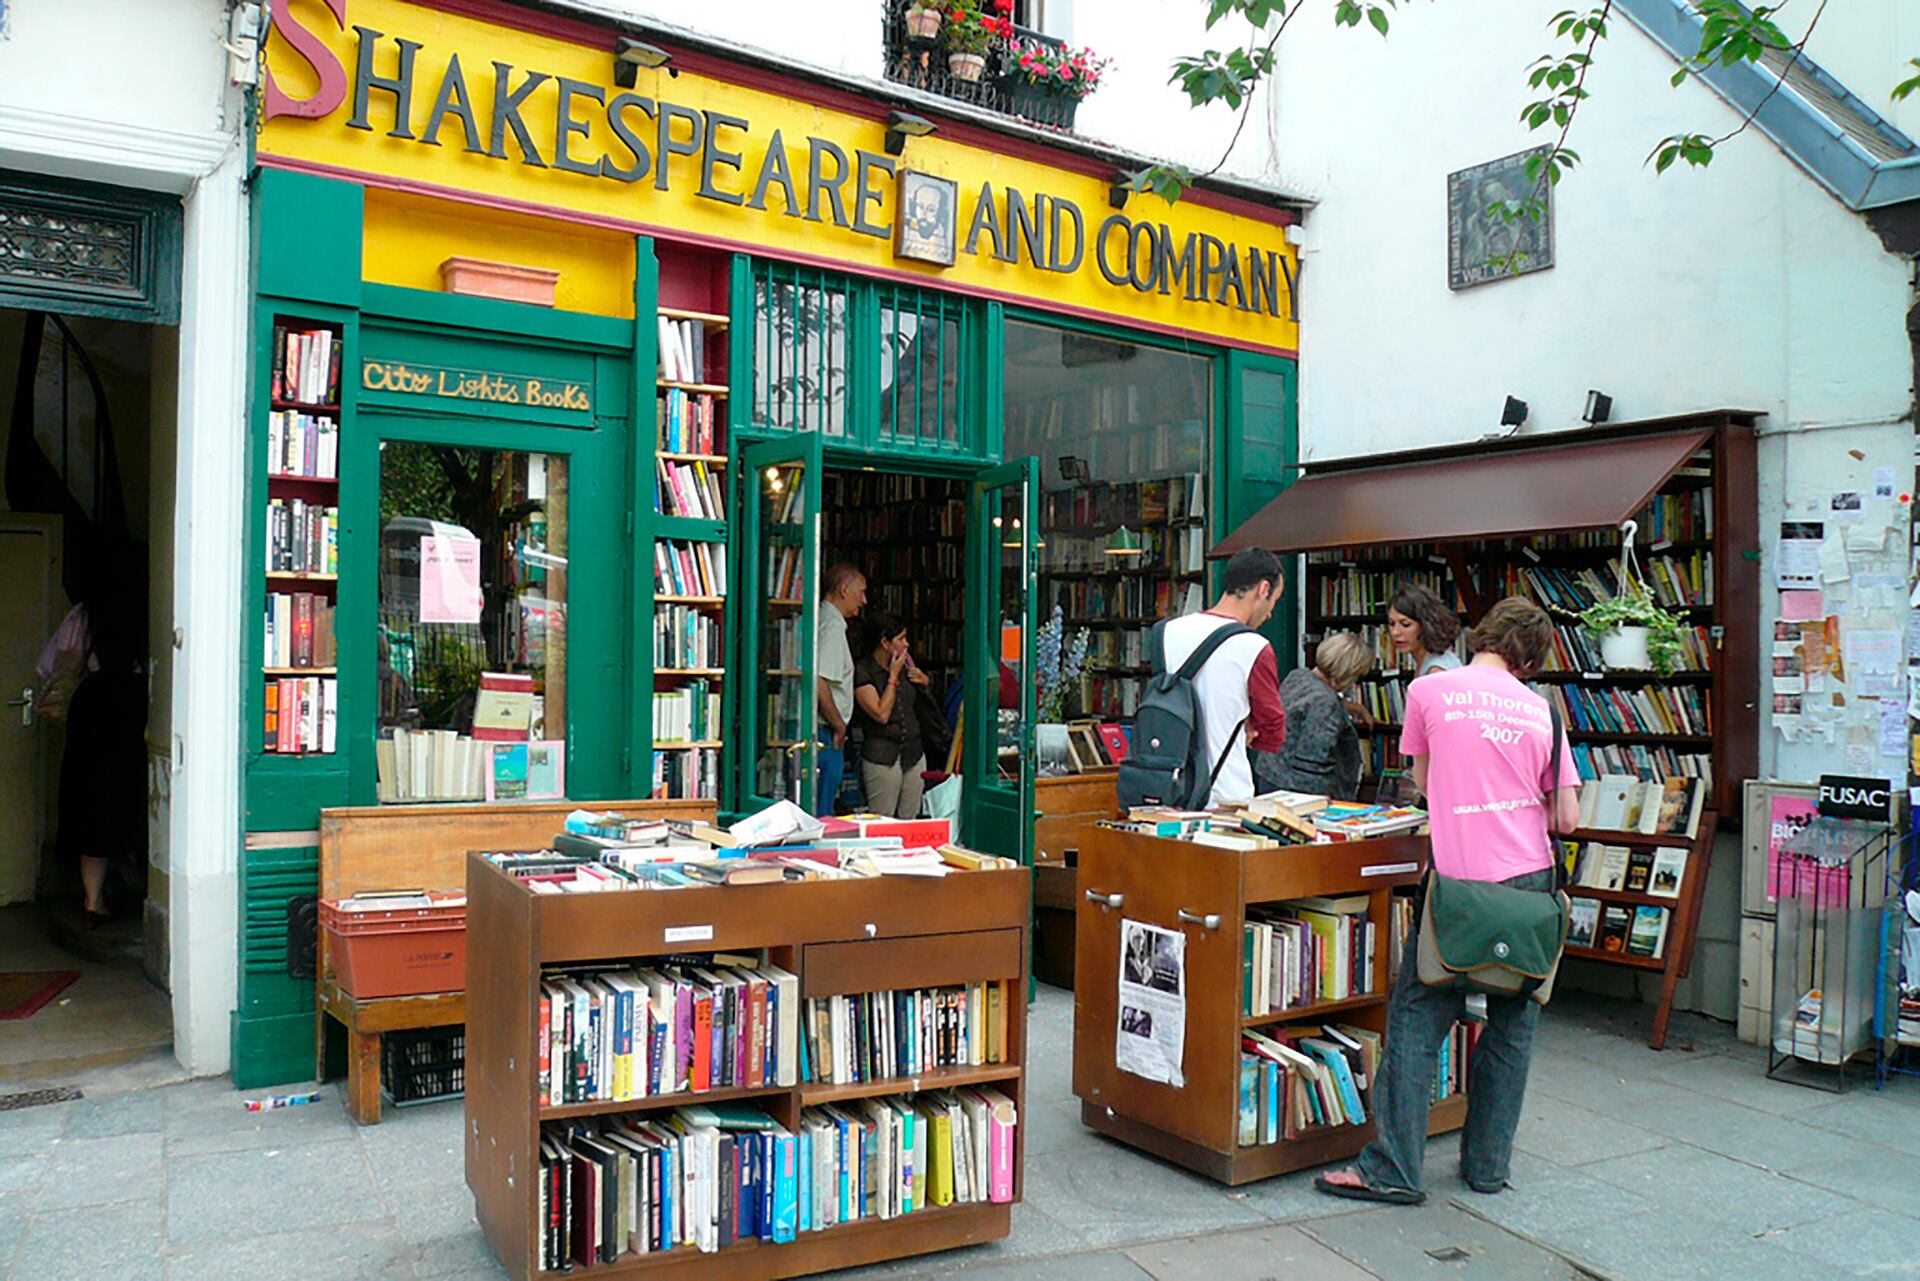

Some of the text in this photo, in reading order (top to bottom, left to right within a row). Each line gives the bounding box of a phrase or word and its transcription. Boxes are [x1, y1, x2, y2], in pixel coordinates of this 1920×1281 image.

[265, 0, 1301, 323] SHAKESPEARE AND COMPANY
[1441, 689, 1473, 706] Val
[1480, 723, 1524, 744] 2007
[1819, 785, 1886, 807] FUSAC
